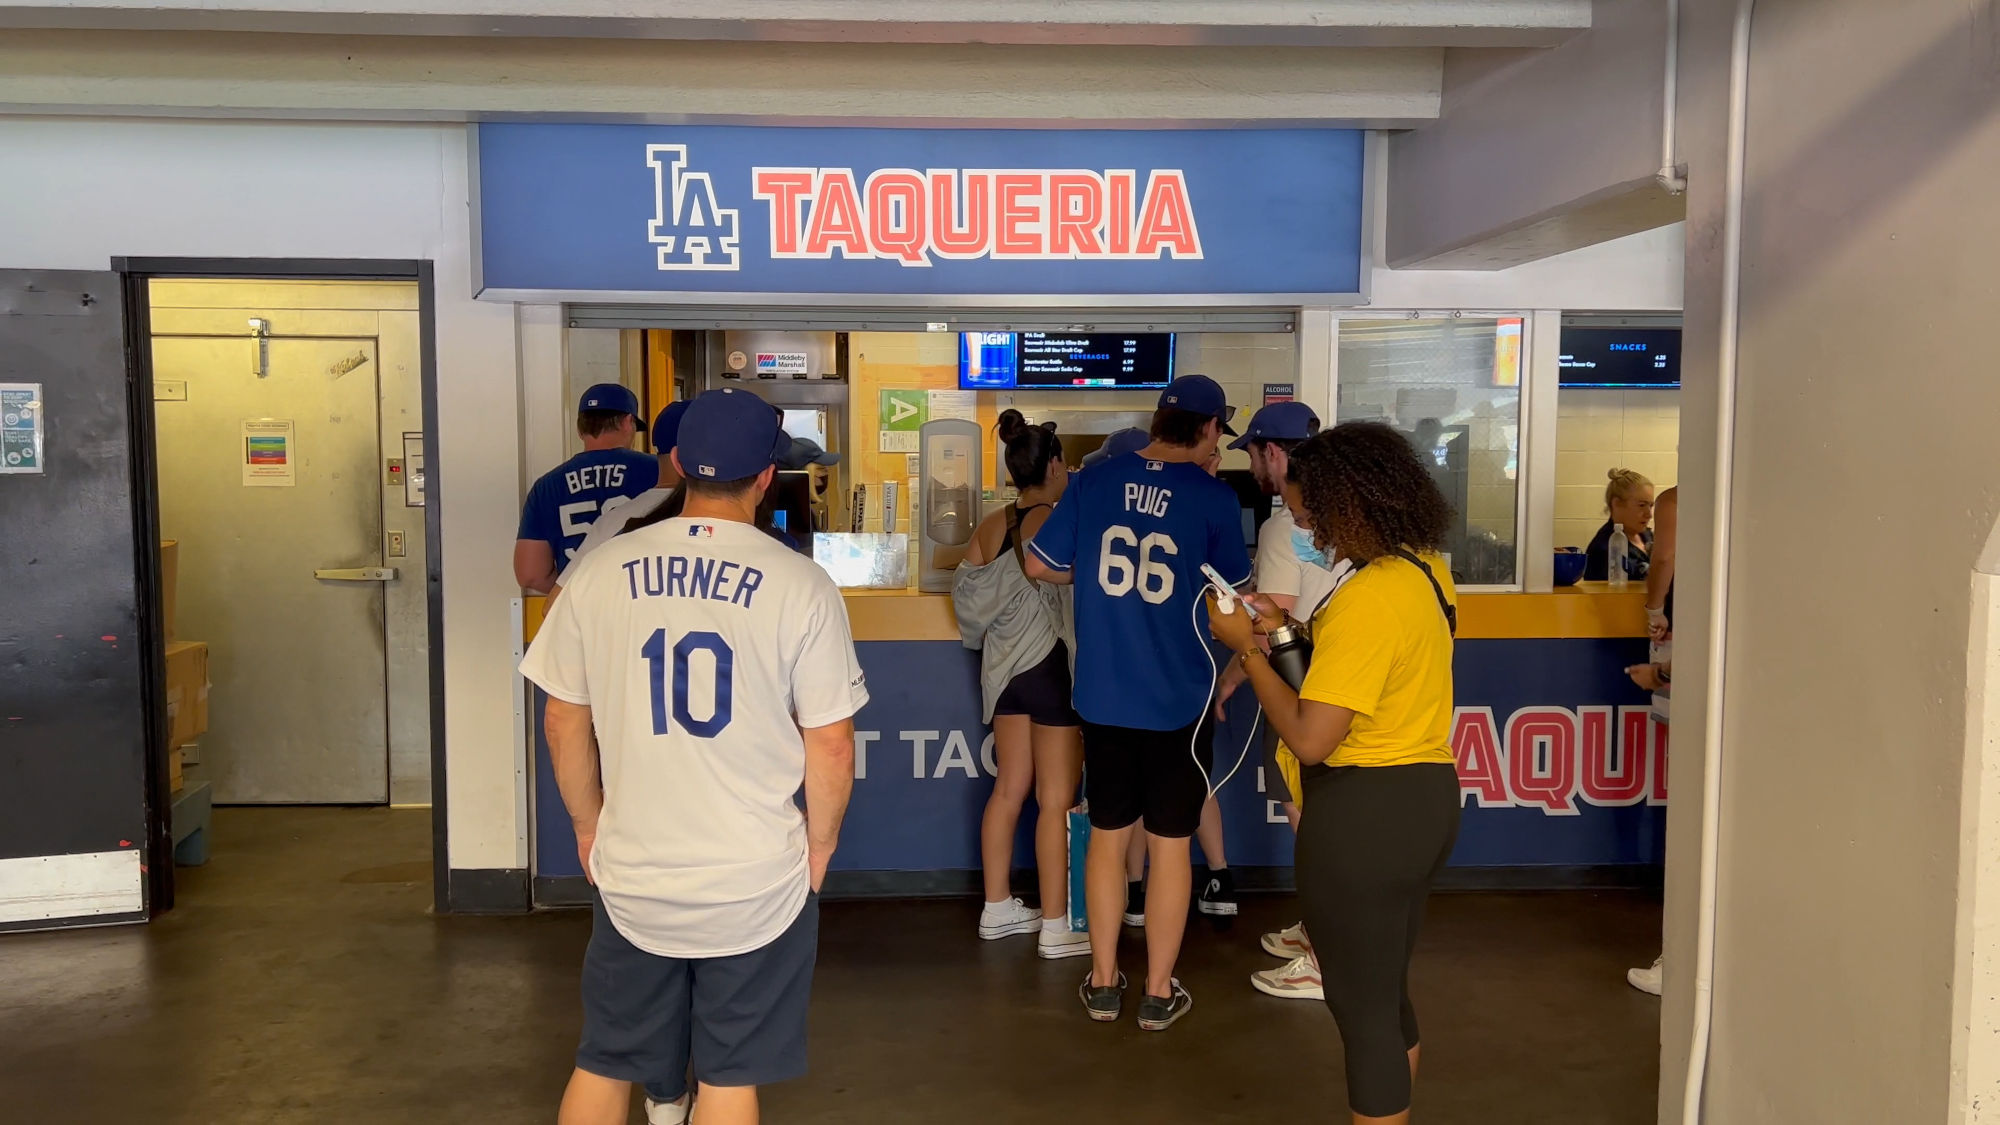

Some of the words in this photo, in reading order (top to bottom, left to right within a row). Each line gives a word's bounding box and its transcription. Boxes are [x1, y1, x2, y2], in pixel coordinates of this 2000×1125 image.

[646, 143, 740, 271] LA
[752, 166, 1205, 268] TAQUERIA
[890, 396, 918, 424] A
[564, 464, 627, 495] BETTS
[1124, 482, 1172, 518] PUIG
[622, 555, 764, 610] TURNER
[1098, 524, 1179, 605] 66
[640, 628, 734, 738] 10
